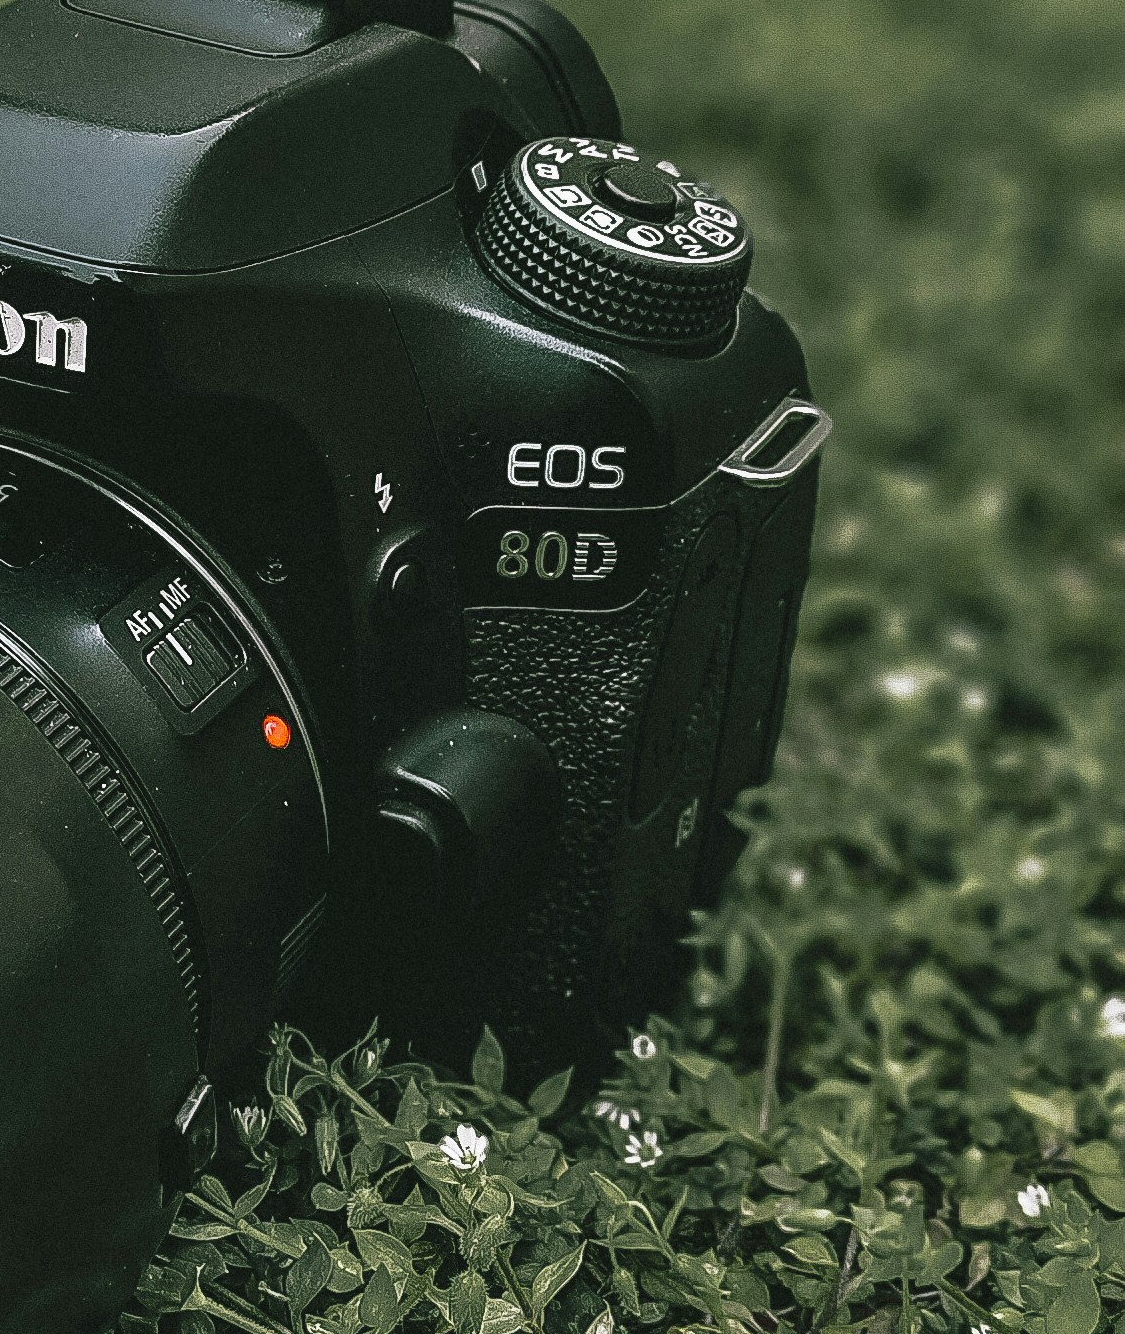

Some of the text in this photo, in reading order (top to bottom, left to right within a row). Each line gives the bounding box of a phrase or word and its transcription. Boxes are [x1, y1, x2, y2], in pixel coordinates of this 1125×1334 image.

[535, 163, 560, 180] B
[538, 144, 574, 163] M
[664, 225, 709, 257] SCN
[507, 442, 626, 489] EOS
[496, 530, 618, 581] 80D
[125, 576, 190, 641] AF MF
